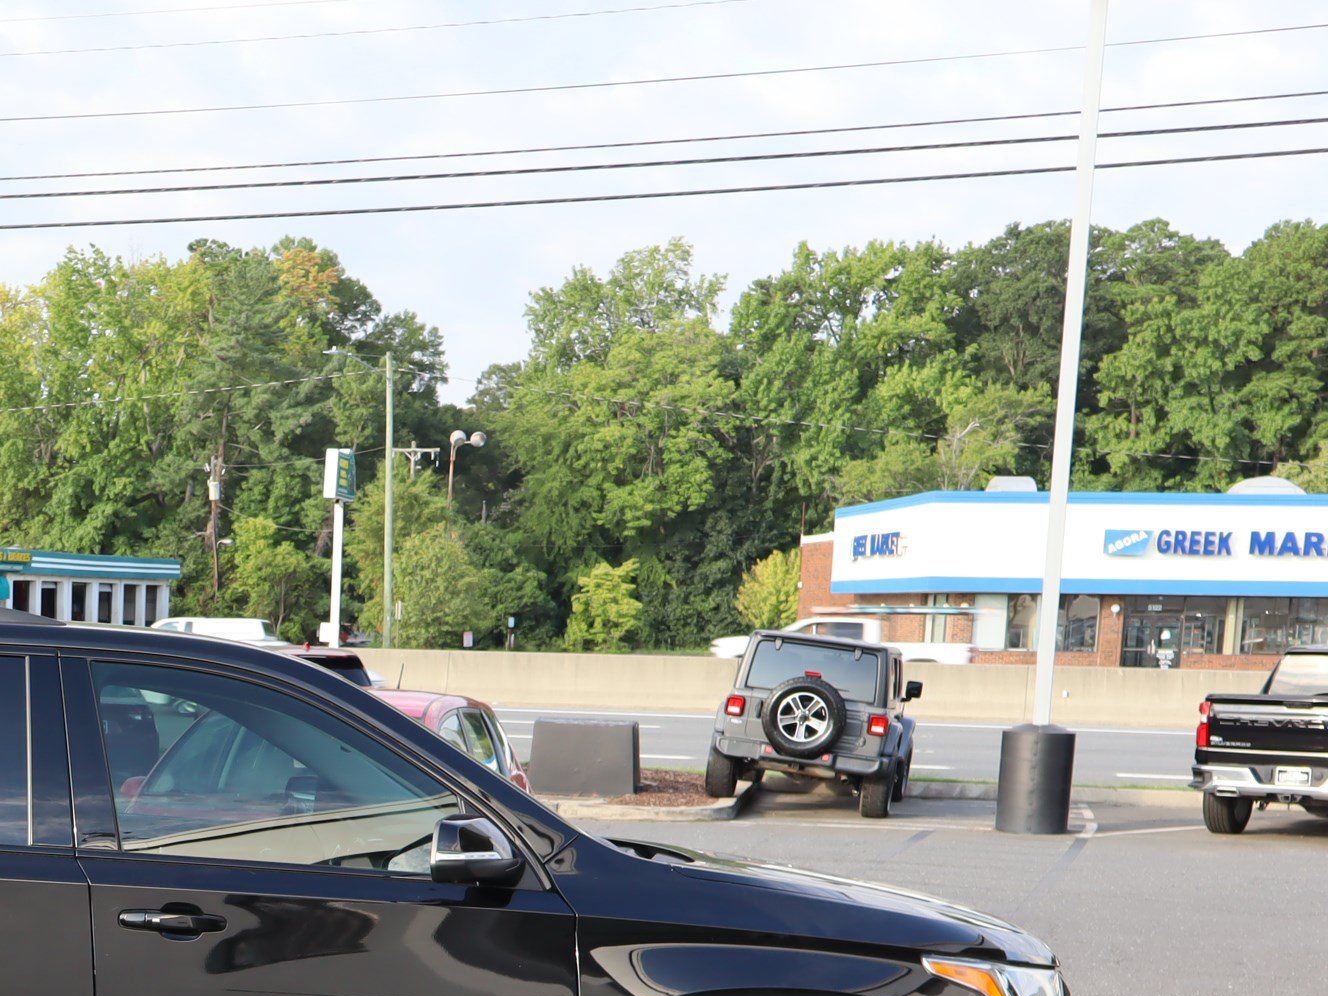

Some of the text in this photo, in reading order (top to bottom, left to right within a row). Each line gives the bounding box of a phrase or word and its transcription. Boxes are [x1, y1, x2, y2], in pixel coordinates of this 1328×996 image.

[1107, 530, 1149, 555] AGORA
[1157, 529, 1328, 557] GREEK MAR
